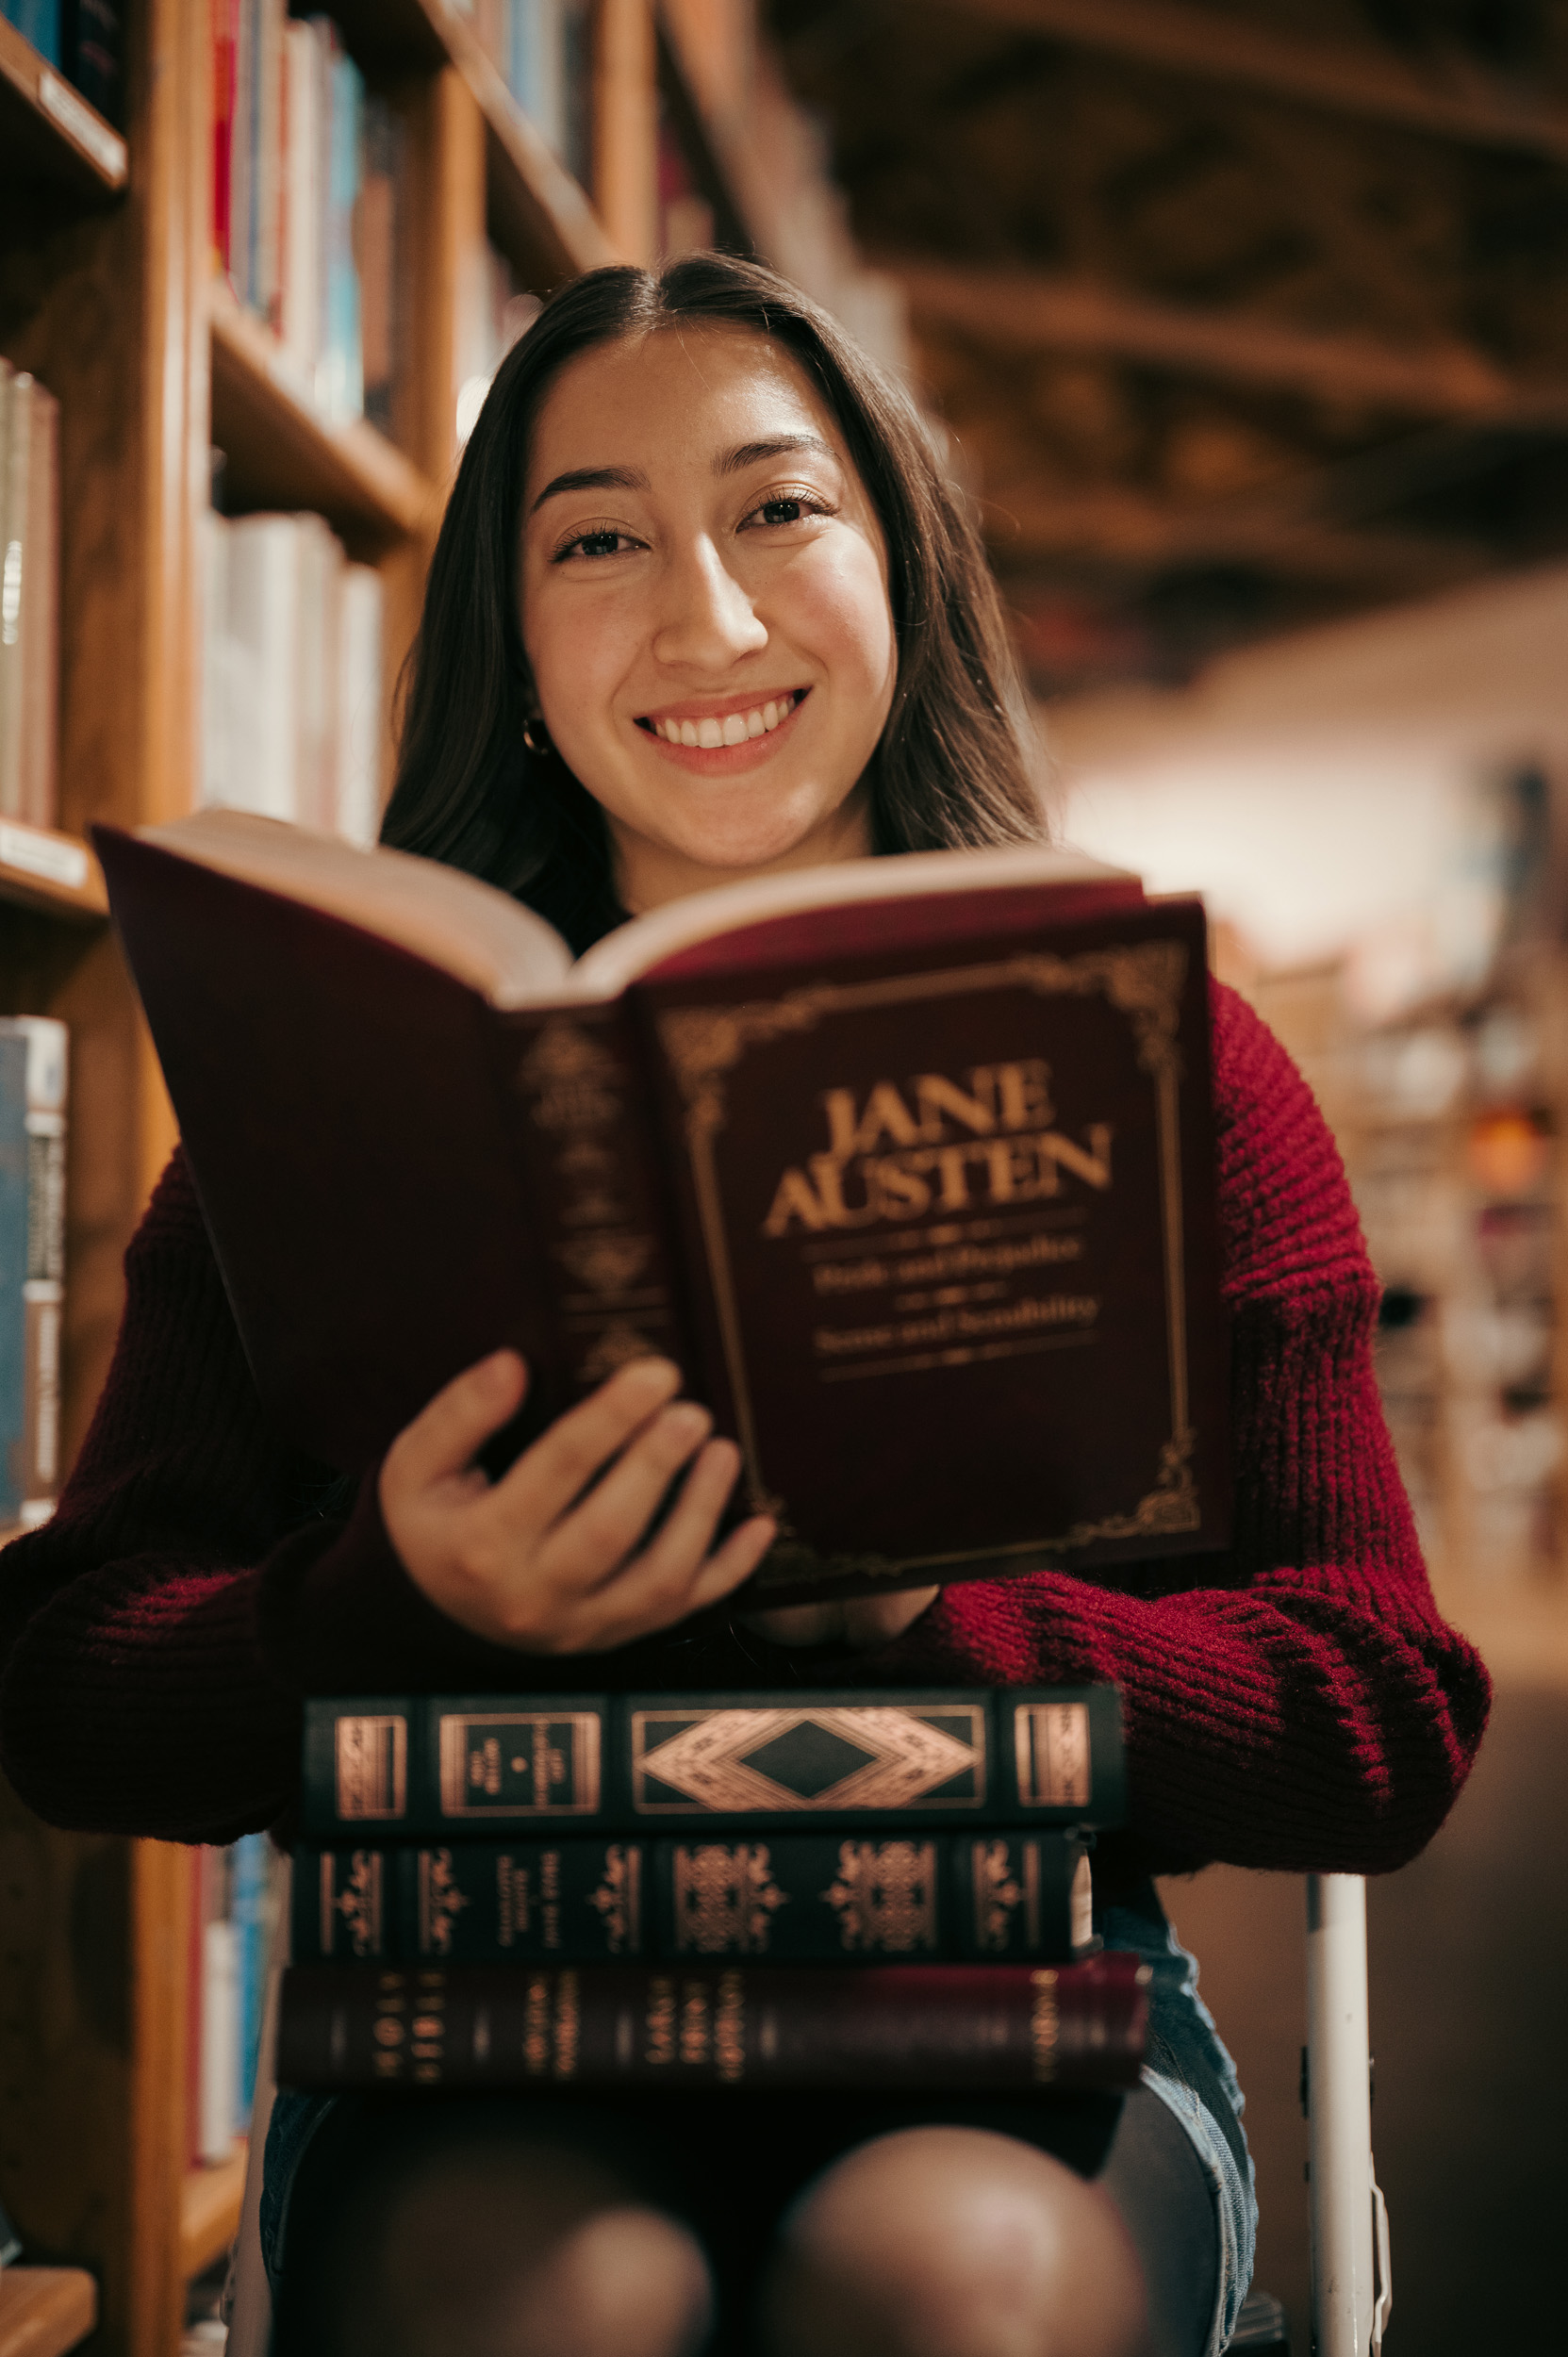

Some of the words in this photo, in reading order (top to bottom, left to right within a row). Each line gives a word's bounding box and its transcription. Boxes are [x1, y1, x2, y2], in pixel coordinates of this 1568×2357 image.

[822, 1058, 1056, 1158] JANE
[765, 1124, 1112, 1237] AUSTEN
[815, 1322, 892, 1356] Sense
[900, 1310, 952, 1345] and
[956, 1292, 1099, 1334] Sensibility
